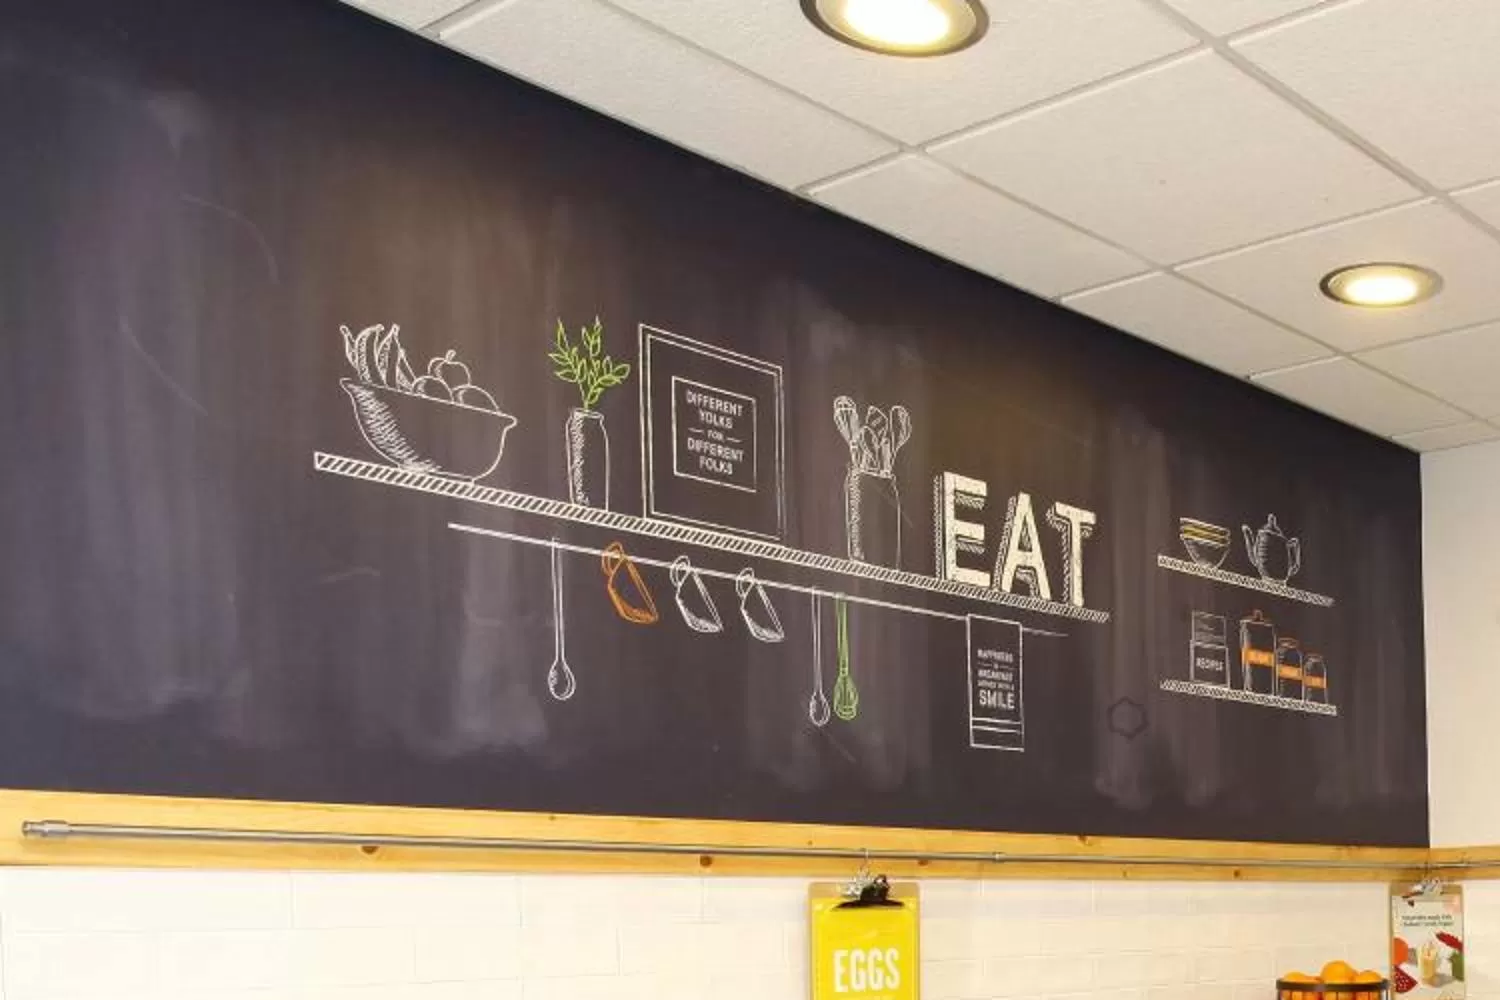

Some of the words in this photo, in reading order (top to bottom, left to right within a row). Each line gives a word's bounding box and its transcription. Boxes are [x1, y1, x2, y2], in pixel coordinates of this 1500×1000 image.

[686, 389, 743, 416] DIFFERENT
[699, 408, 733, 429] YOLKS
[707, 430, 724, 441] FOR
[687, 437, 744, 462] DIFFERENT
[700, 455, 733, 475] FOLKS
[935, 471, 1096, 607] EAT
[979, 689, 1015, 709] SMILE
[833, 948, 901, 993] EGGS
